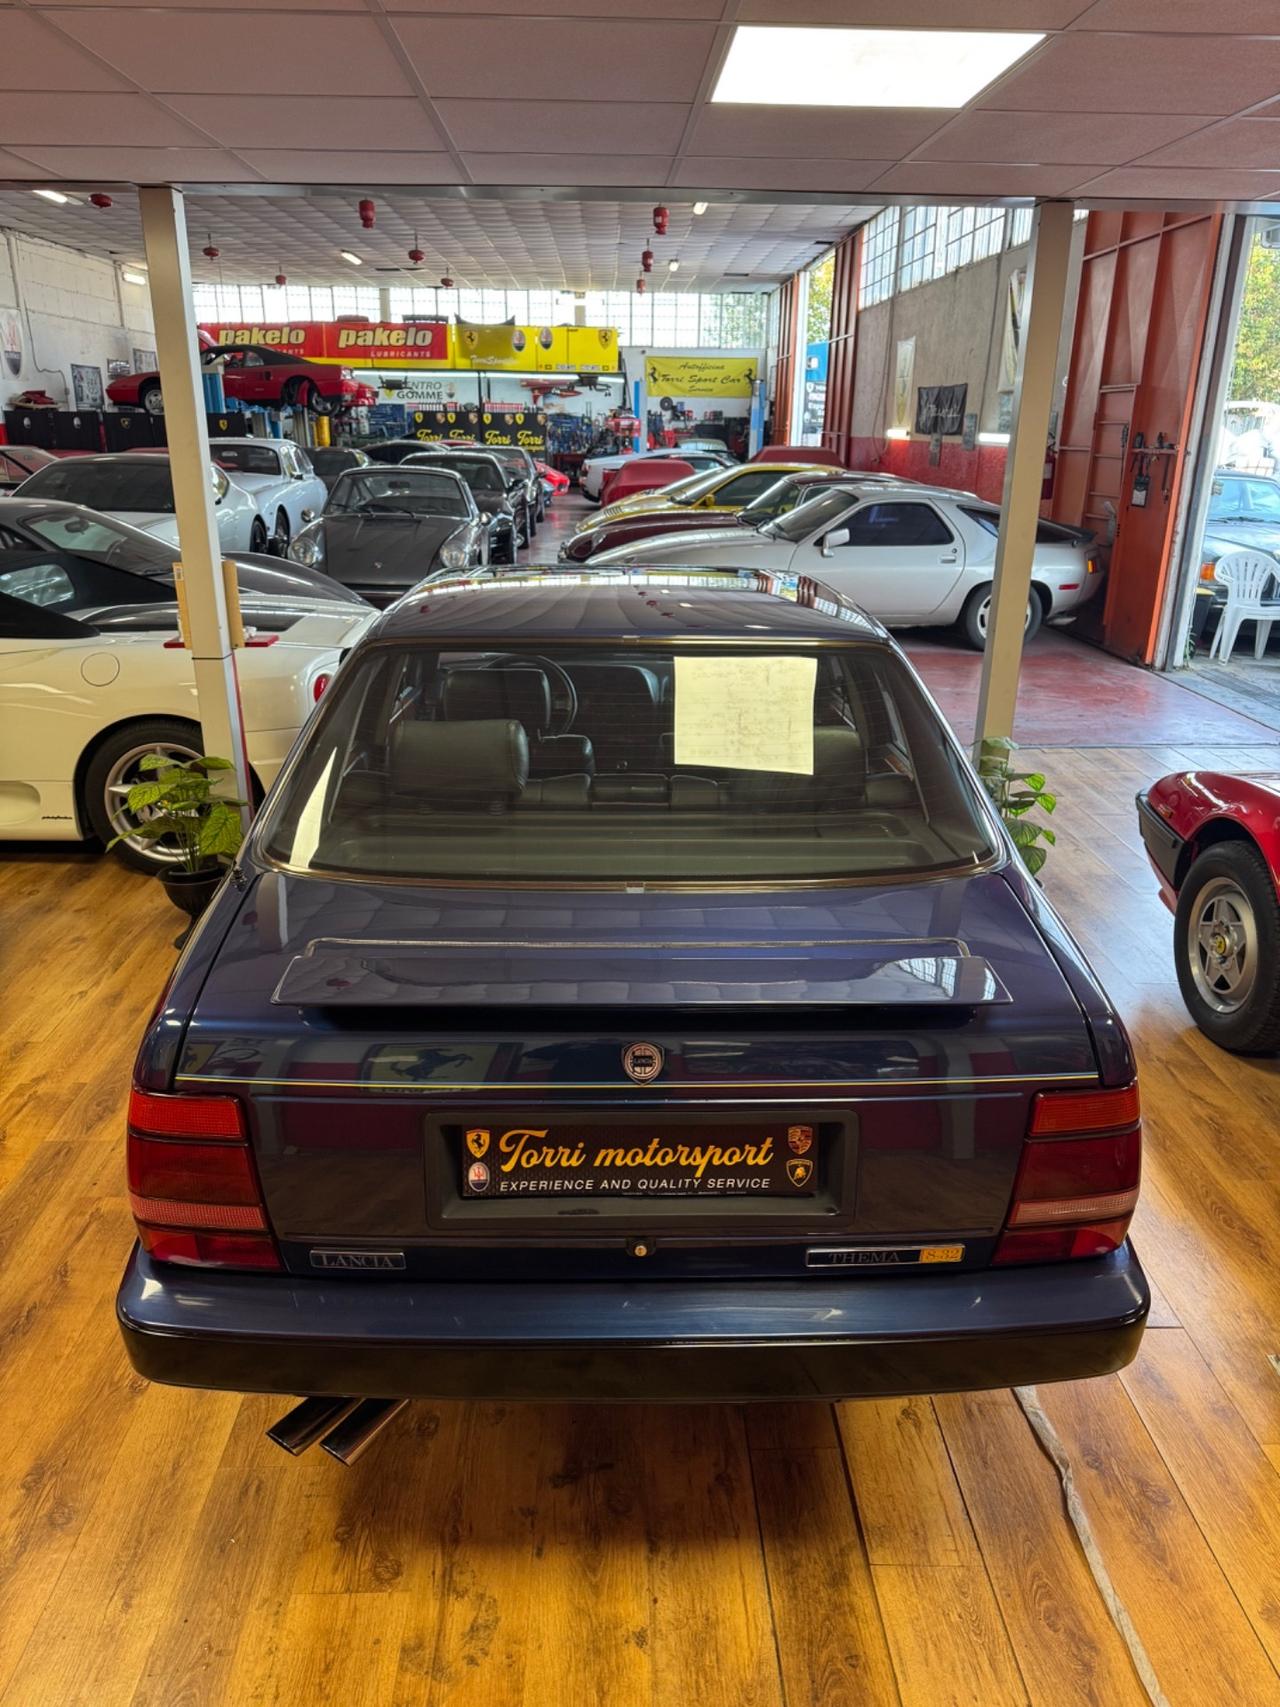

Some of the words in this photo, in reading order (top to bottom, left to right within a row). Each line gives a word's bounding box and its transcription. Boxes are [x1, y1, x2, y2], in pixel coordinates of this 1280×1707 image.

[219, 327, 306, 346] pakelo
[338, 327, 434, 348] pakelo
[688, 375, 717, 384] Sport
[721, 375, 741, 384] Car
[397, 390, 443, 400] GOMME
[485, 430, 511, 445] Torri
[517, 430, 543, 445] Torri
[499, 1129, 586, 1172] Torri
[593, 1137, 774, 1178] motorsport
[500, 1179, 595, 1191] EXPERIENCE
[600, 1179, 632, 1190] AND
[637, 1178, 702, 1190] QUALITY
[707, 1178, 771, 1189] SERVICE
[320, 1254, 394, 1267] LANCIA
[828, 1251, 901, 1264] THEMA
